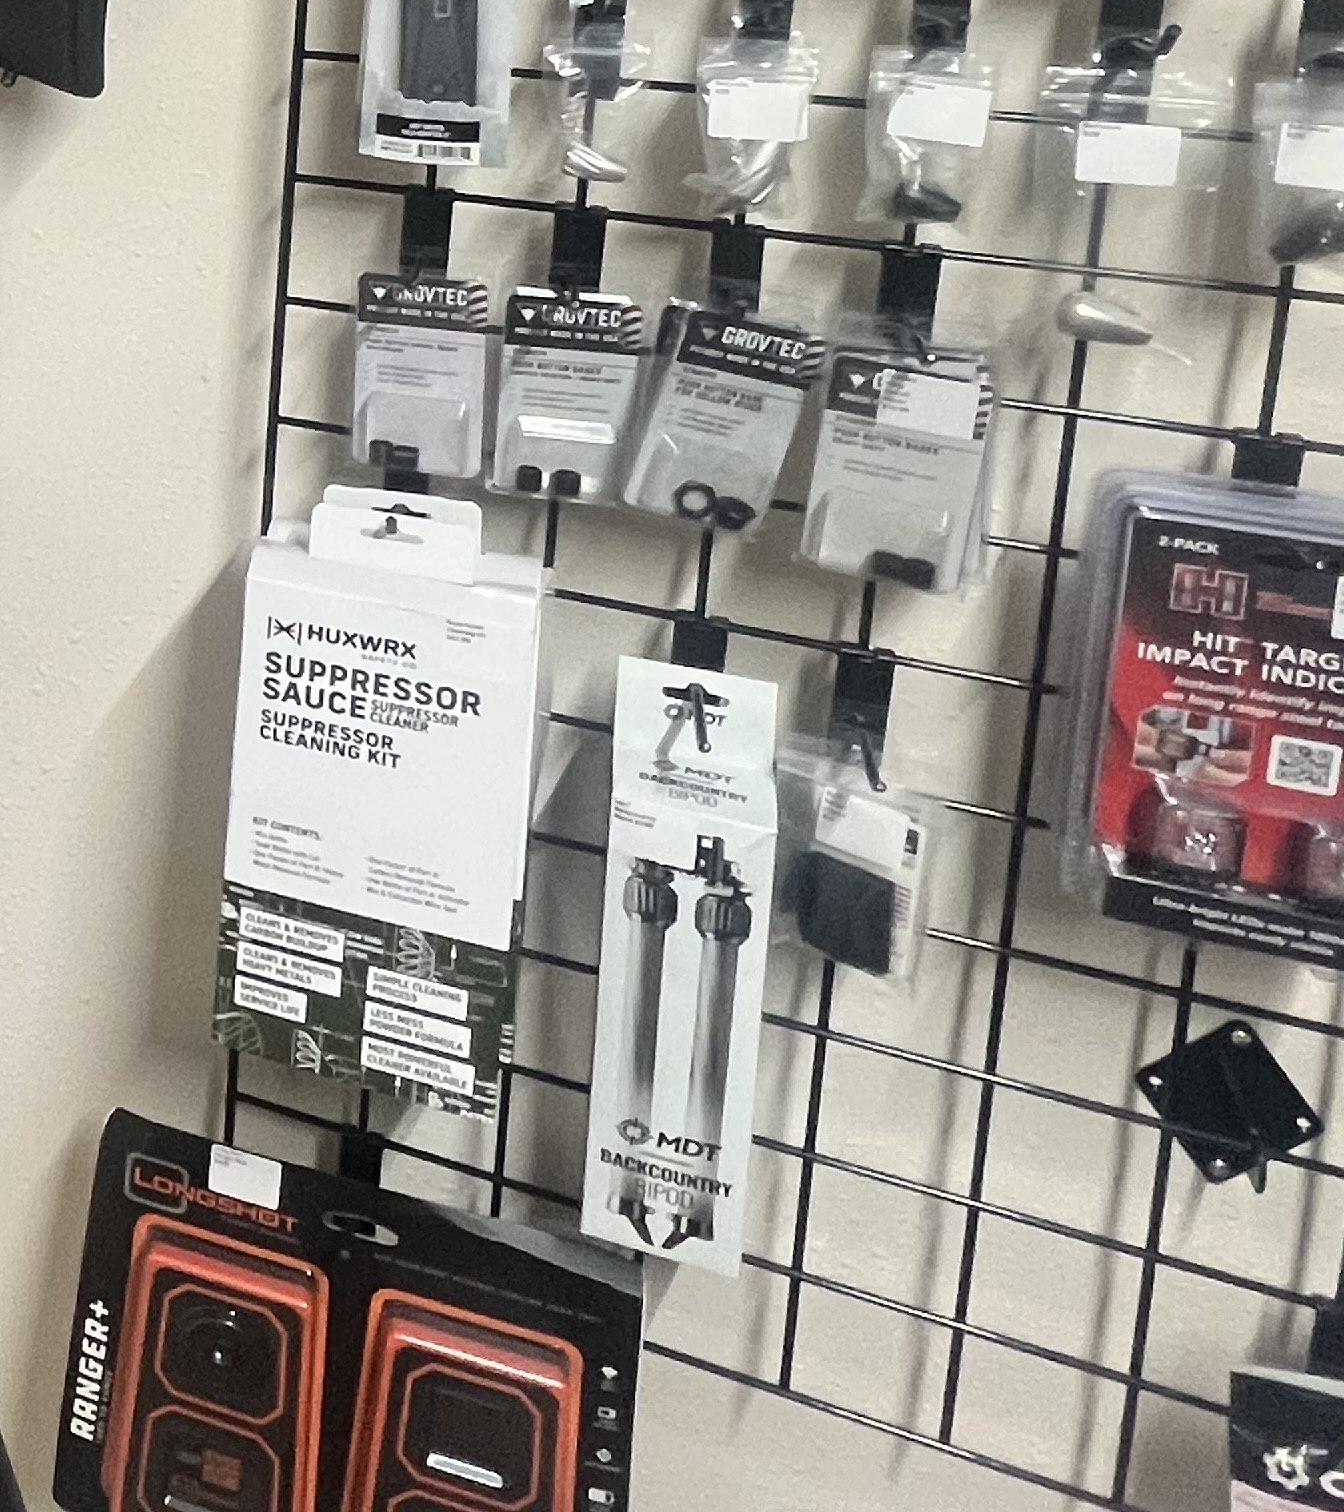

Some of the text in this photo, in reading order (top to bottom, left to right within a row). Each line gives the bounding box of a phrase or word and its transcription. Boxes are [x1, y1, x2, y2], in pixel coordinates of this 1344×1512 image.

[721, 326, 806, 360] GROVTEC
[1158, 535, 1220, 555] 2-PACK
[307, 623, 417, 660] HUXWRX
[1192, 630, 1344, 671] HIT TARG
[264, 650, 482, 717] SUPPRESSOR
[1137, 642, 1344, 695] IMPACT INDIC
[262, 676, 367, 719] SAUCE
[370, 698, 460, 728] SUPPRESSOR
[261, 708, 394, 751] SUPPRESSOR
[369, 712, 430, 734] CLEANER
[259, 724, 402, 769] CLEANING KIT
[656, 1131, 722, 1162] MDT
[600, 1147, 733, 1198] BACKCOUNTRY
[133, 1165, 300, 1233] LONGSHOT
[635, 1178, 695, 1211] BIPOD
[70, 1298, 110, 1442] RANGER+
